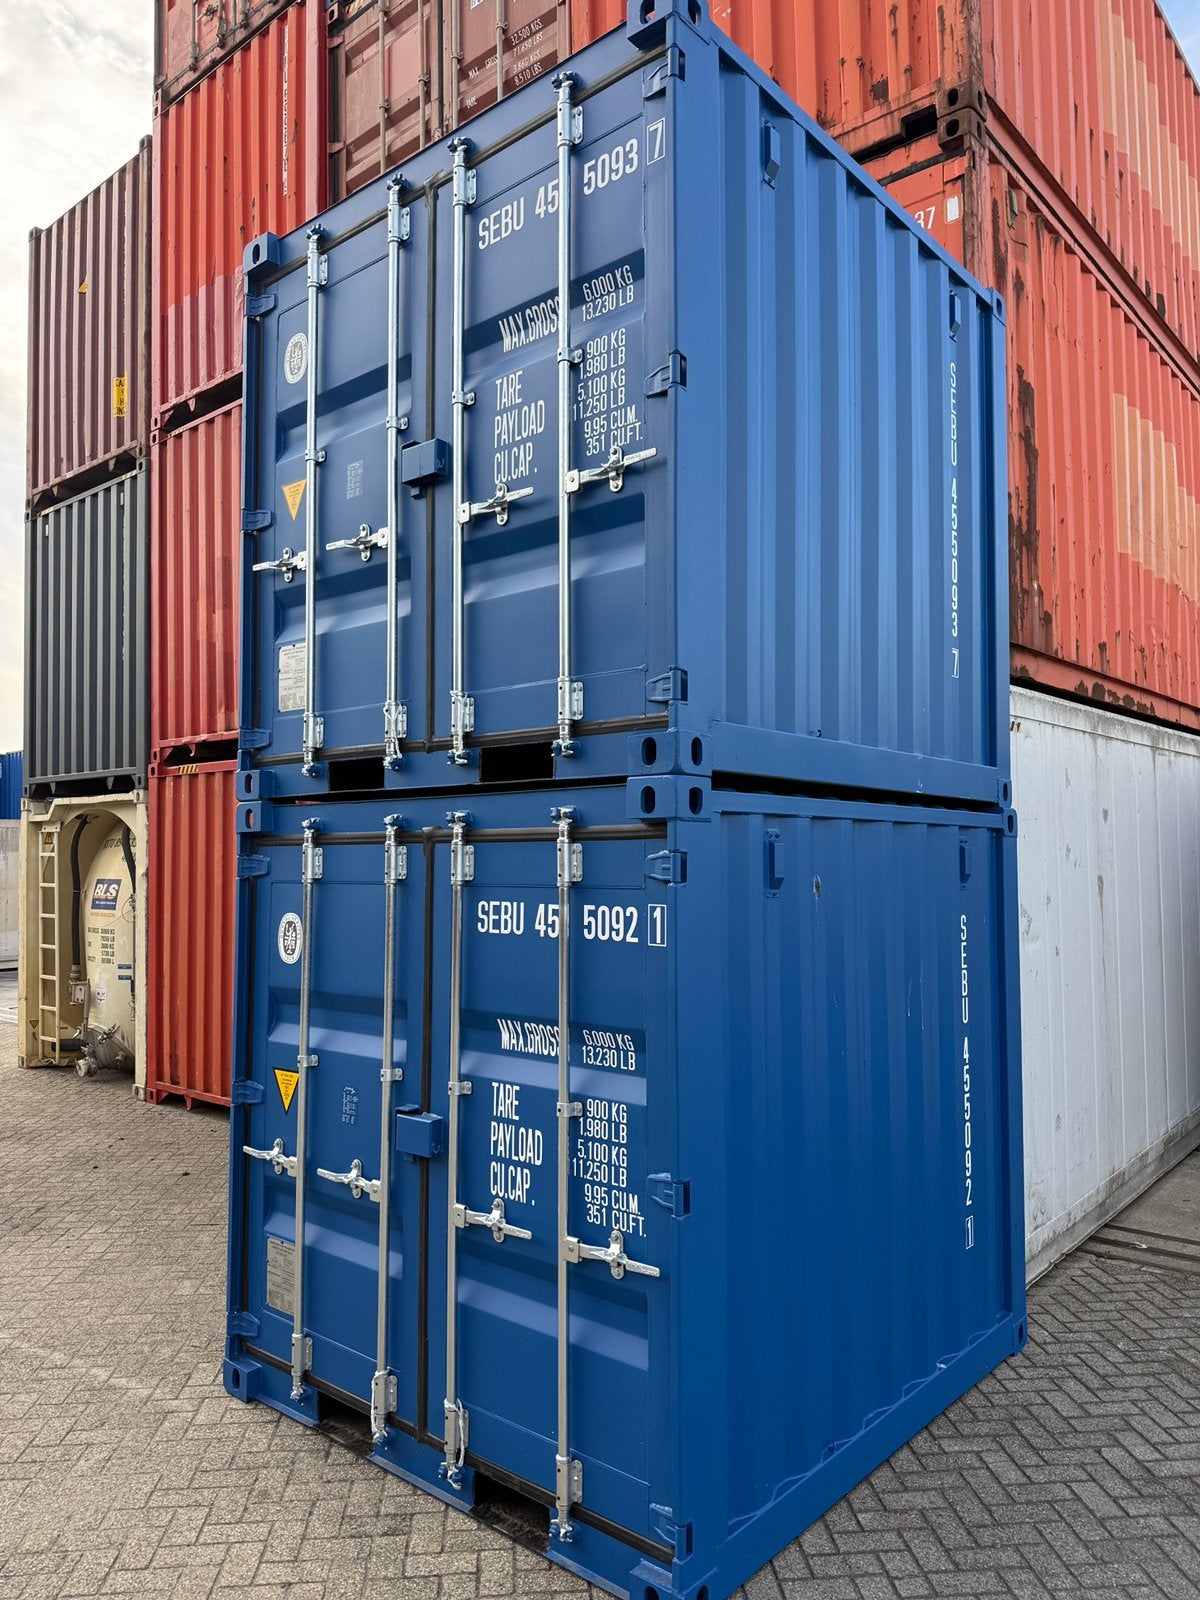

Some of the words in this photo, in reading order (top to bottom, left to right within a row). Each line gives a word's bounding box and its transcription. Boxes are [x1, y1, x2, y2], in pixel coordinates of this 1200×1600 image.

[478, 196, 524, 250] SEBU
[584, 138, 638, 196] 5093
[648, 119, 664, 162] 7
[615, 265, 634, 288] KG
[582, 291, 616, 322] 13.230
[619, 284, 634, 306] LB
[496, 370, 522, 410] TARE
[587, 336, 608, 358] 900
[611, 328, 626, 349] KG
[579, 354, 608, 380] 1.980
[610, 346, 625, 369] LB
[494, 400, 545, 448] PAYLOAD
[578, 375, 608, 400] 5.100
[610, 368, 626, 389] KG
[573, 394, 608, 421] 11.250
[610, 388, 625, 408] LB
[584, 415, 607, 438] 9.95
[586, 436, 605, 456] 351
[94, 884, 118, 899] BLS
[478, 900, 524, 934] SEBU
[584, 904, 638, 943] 5092
[650, 905, 664, 945] 1
[960, 914, 968, 1024] SEBU
[616, 1032, 634, 1052] KG
[620, 1050, 636, 1071] LB
[492, 1082, 520, 1121] TARE
[586, 1099, 608, 1120] 900
[612, 1102, 627, 1124] KG
[579, 1117, 608, 1140] 1.980
[612, 1122, 627, 1144] LB
[963, 1037, 972, 1206] 455092
[490, 1121, 542, 1166] PAYLOAD
[612, 1146, 627, 1168] KG
[612, 1166, 627, 1188] LB
[584, 1184, 608, 1207] 9.95
[612, 1190, 641, 1215] CU.M.
[586, 1204, 606, 1226] 351
[612, 1210, 646, 1237] CU.FT.
[966, 1217, 973, 1248] 1
